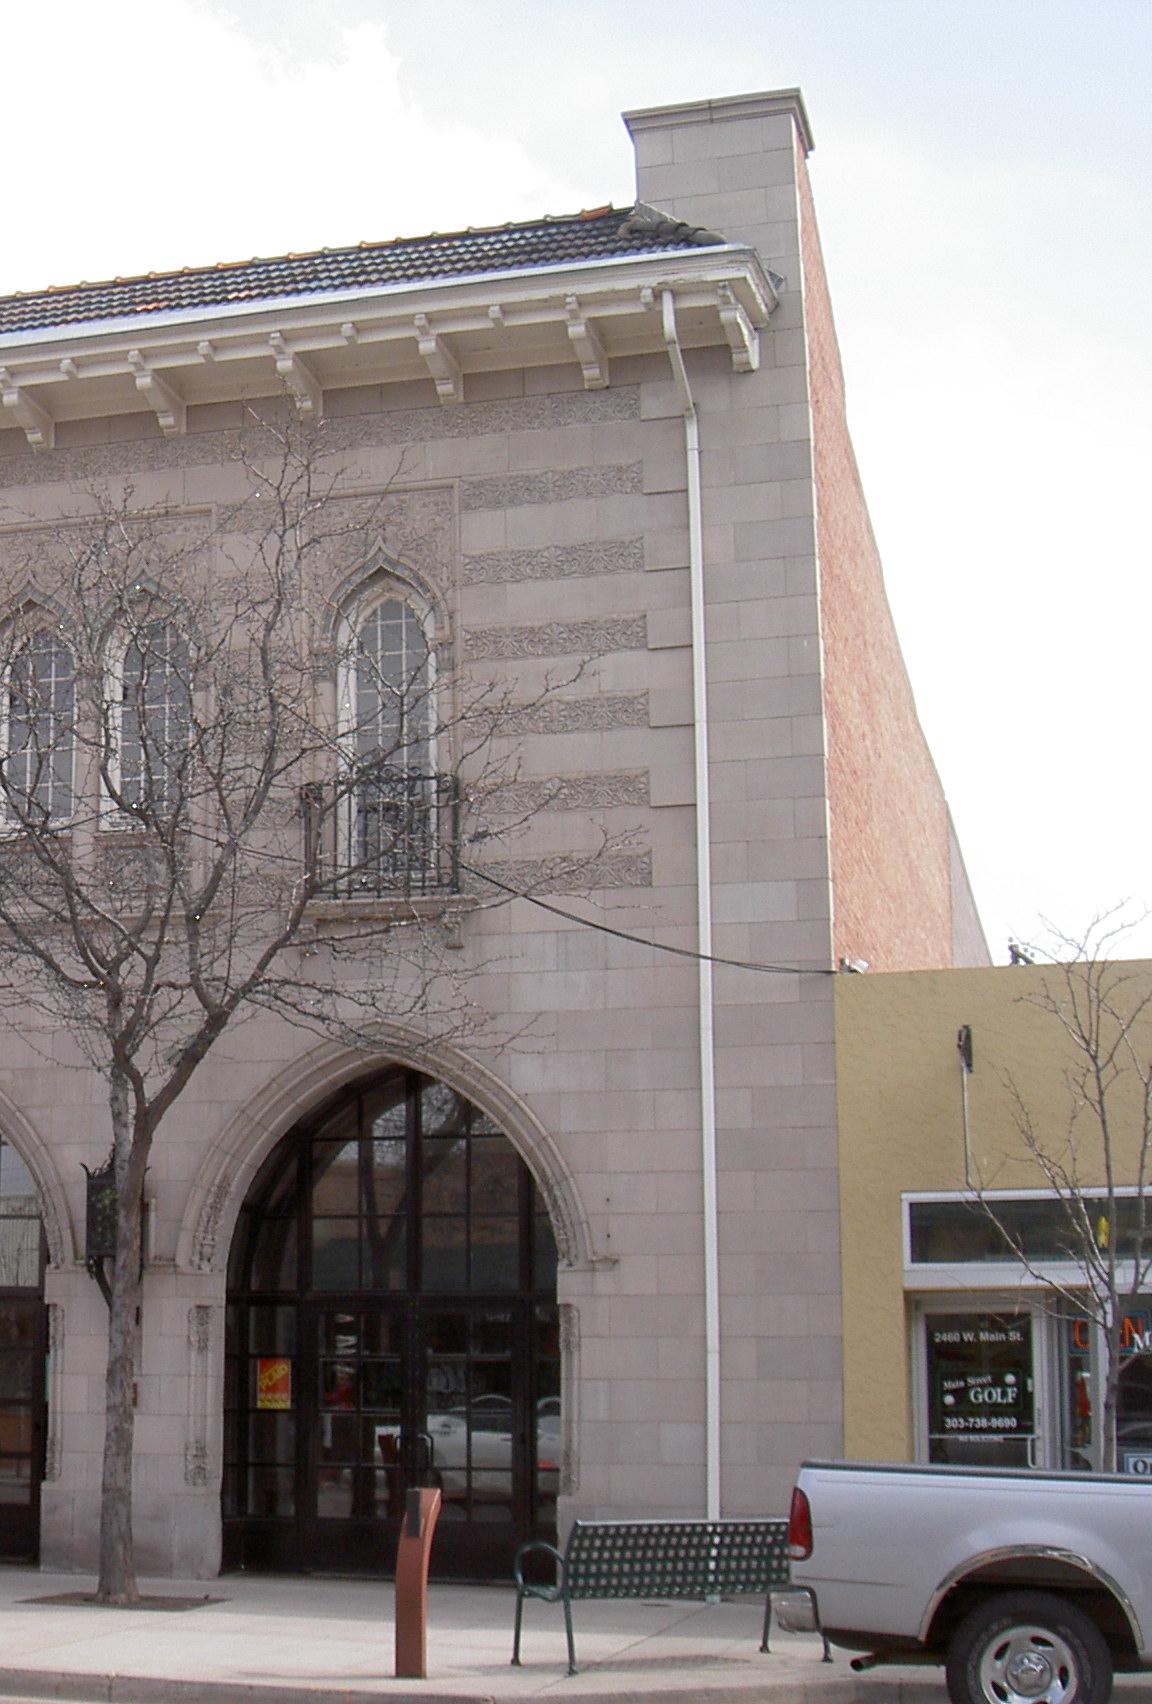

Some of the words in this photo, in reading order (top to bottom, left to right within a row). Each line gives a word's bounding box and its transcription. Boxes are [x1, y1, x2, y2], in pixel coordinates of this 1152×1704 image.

[979, 1330, 1007, 1342] Main
[1008, 1330, 1024, 1342] St.
[969, 1386, 1019, 1404] GOLF
